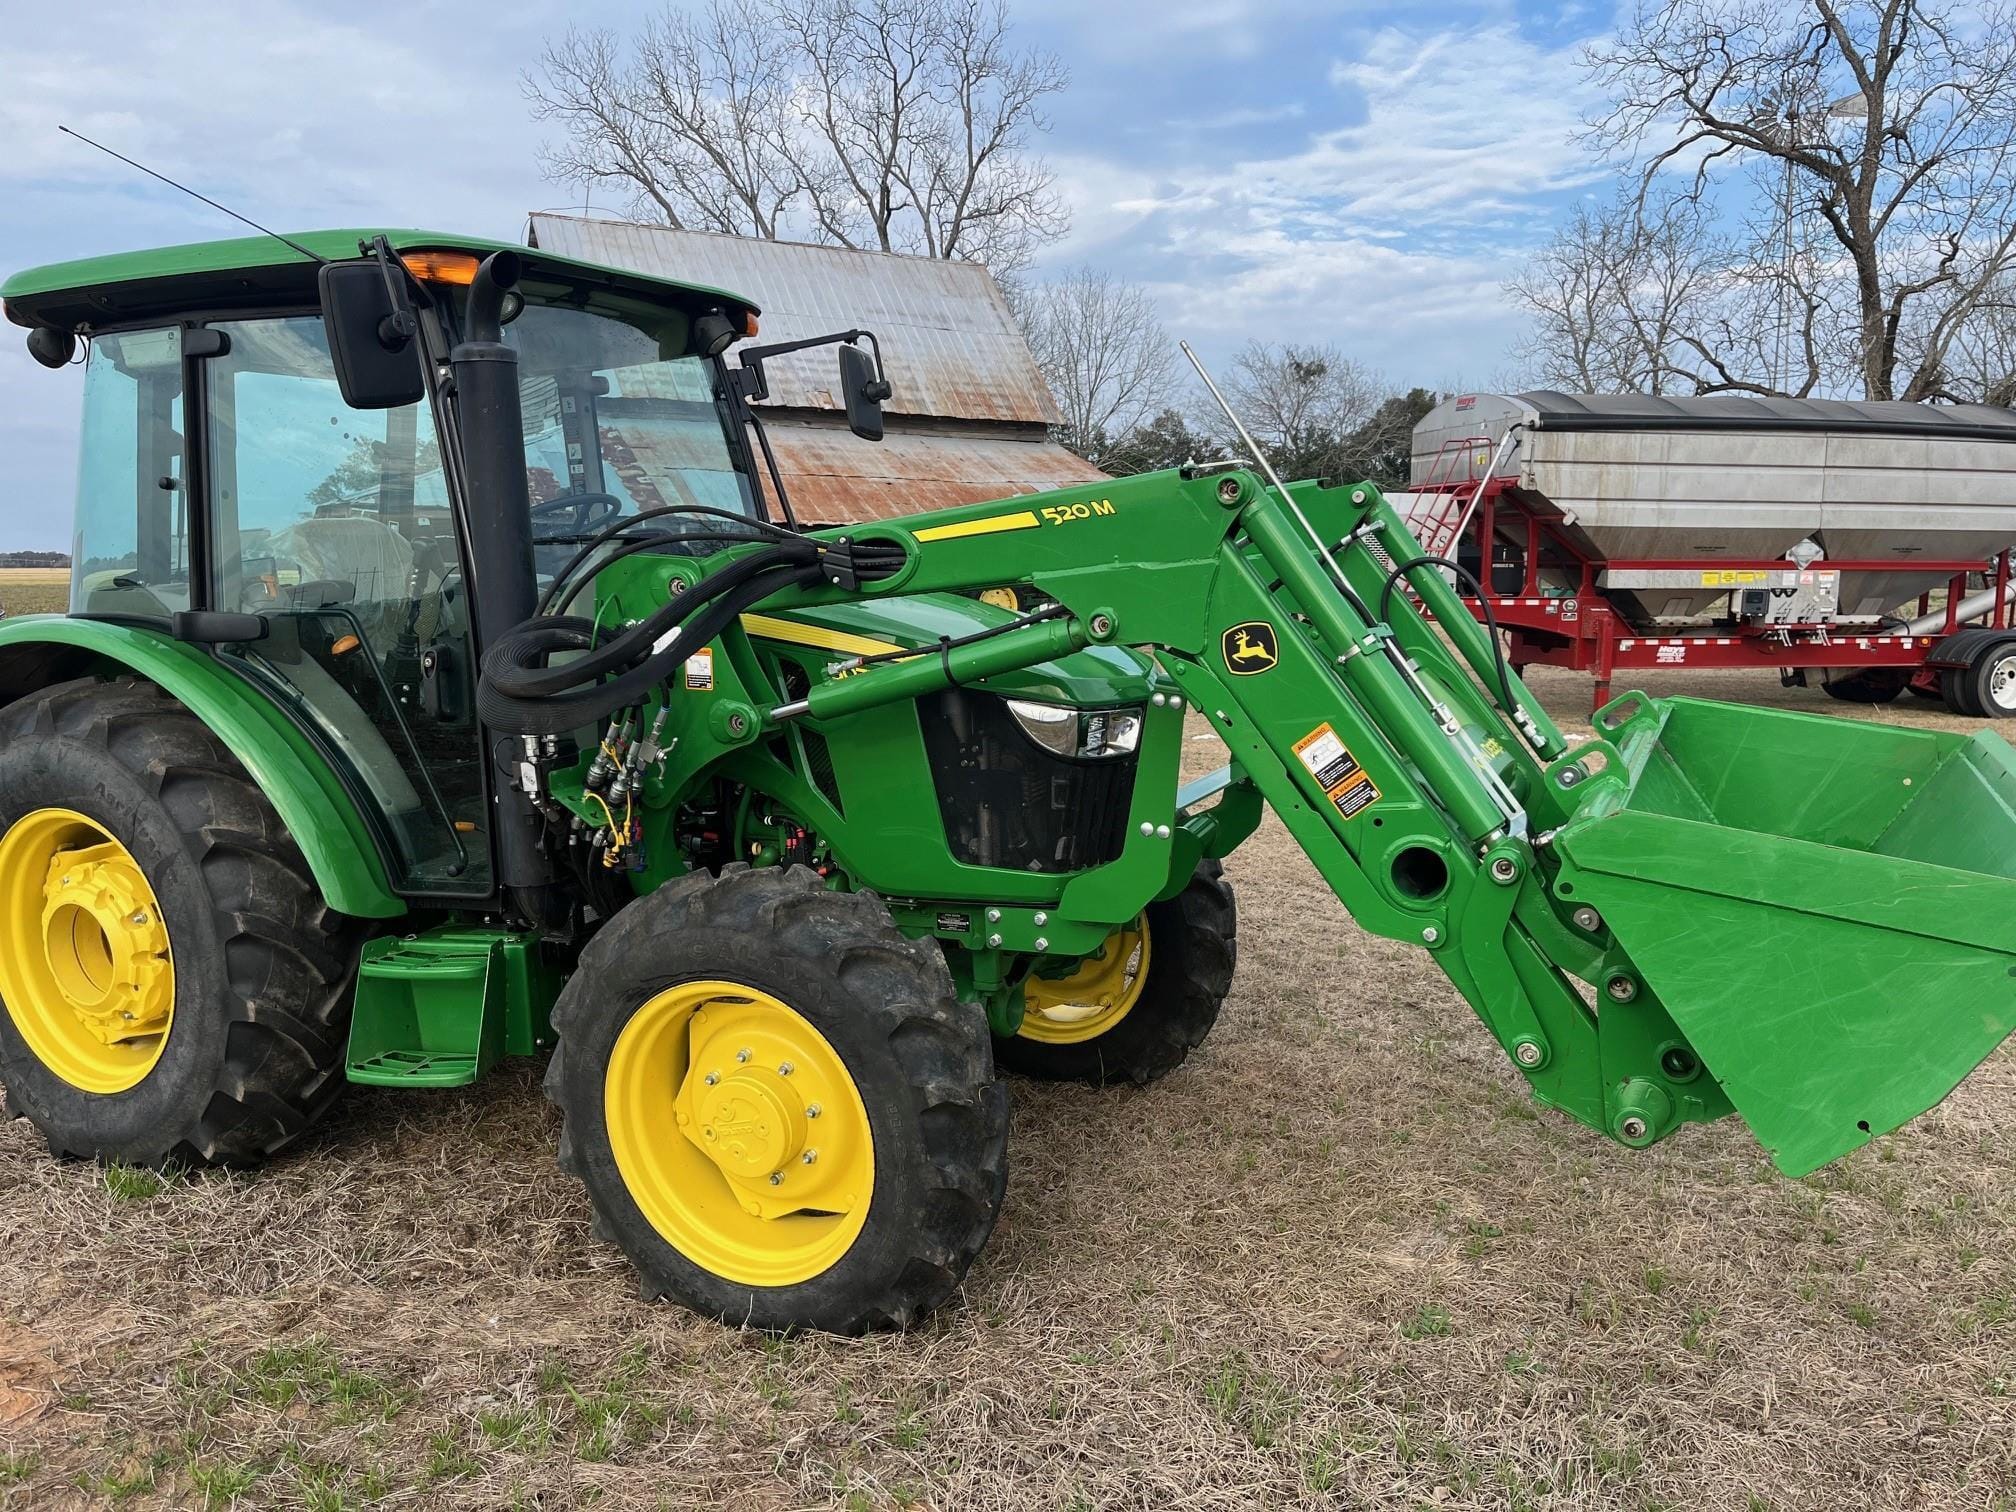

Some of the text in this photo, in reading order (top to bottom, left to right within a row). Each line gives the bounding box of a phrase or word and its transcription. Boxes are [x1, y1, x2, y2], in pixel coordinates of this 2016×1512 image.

[1040, 503, 1091, 526] 520
[1302, 728, 1326, 746] WARNING
[1340, 776, 1363, 794] WARNING
